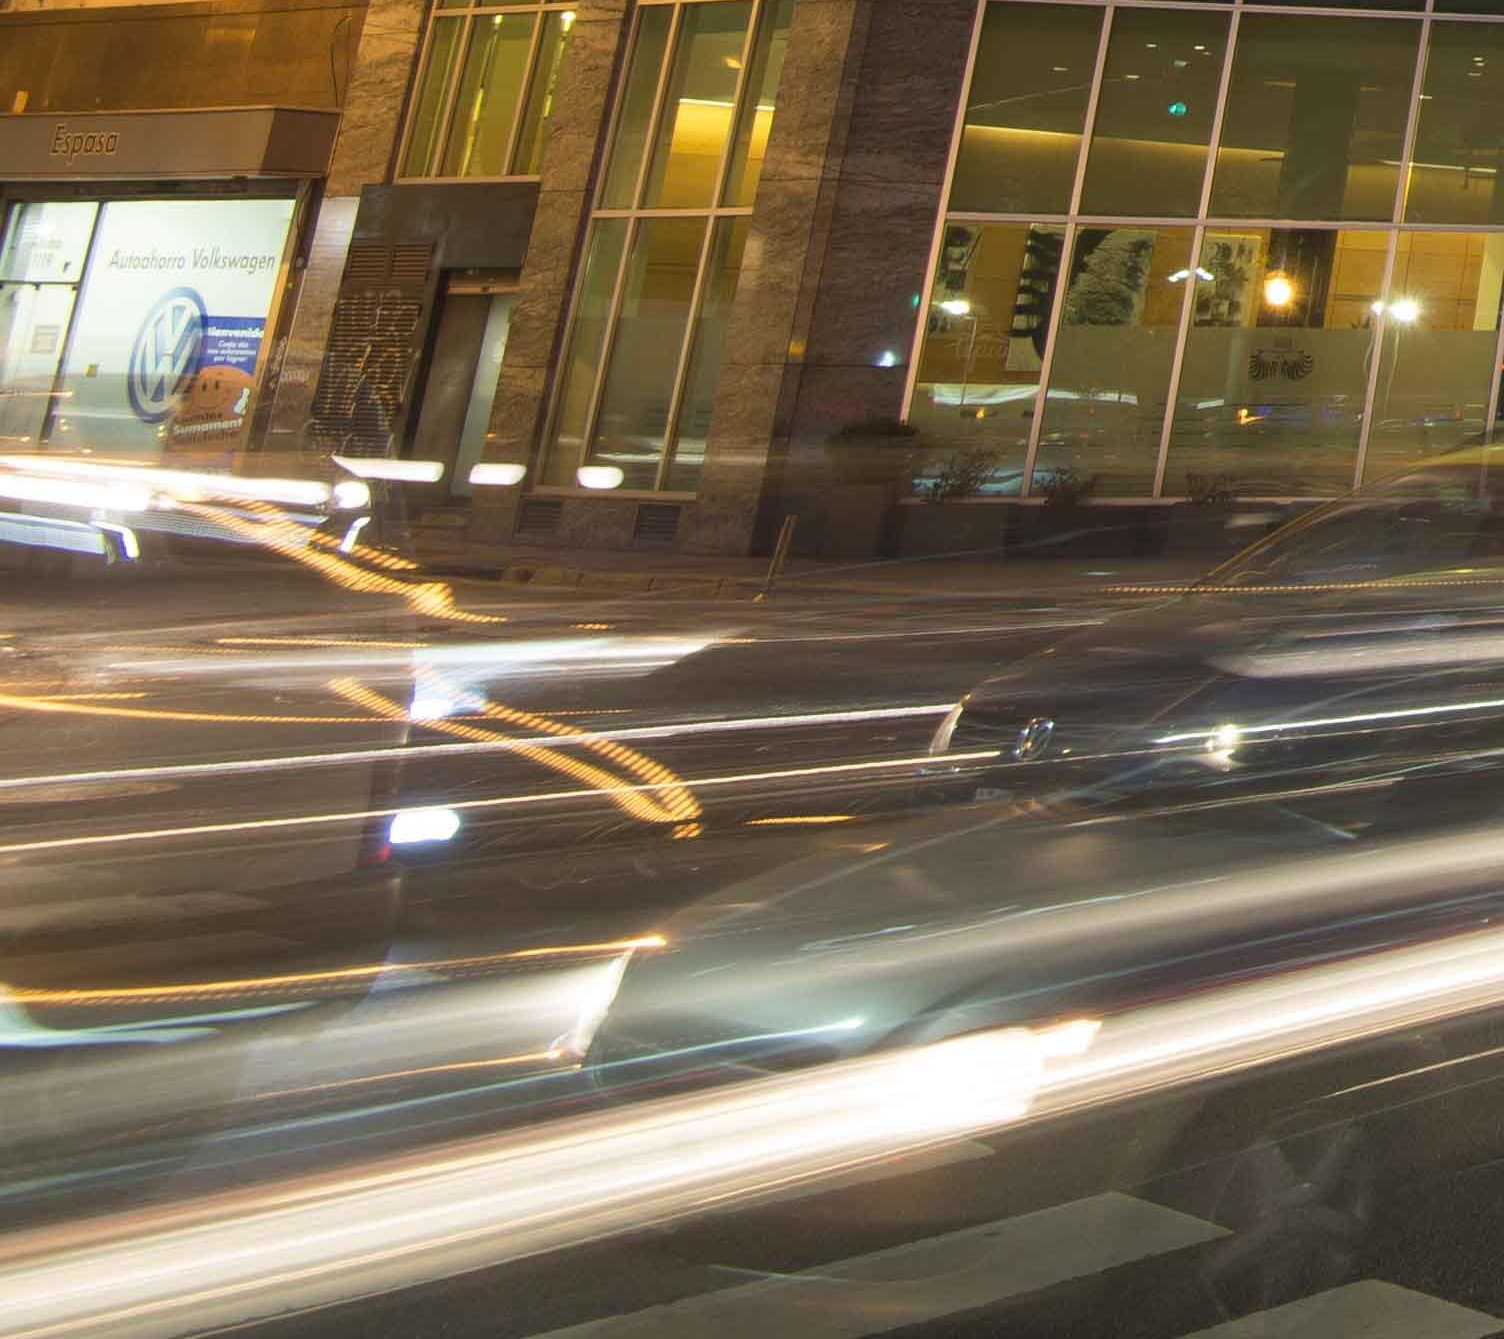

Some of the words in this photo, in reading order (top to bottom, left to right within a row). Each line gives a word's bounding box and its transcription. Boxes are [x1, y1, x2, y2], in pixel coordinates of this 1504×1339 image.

[48, 122, 121, 167] Espasa
[108, 247, 186, 271] Autoahorro
[191, 245, 276, 275] Volkswagen
